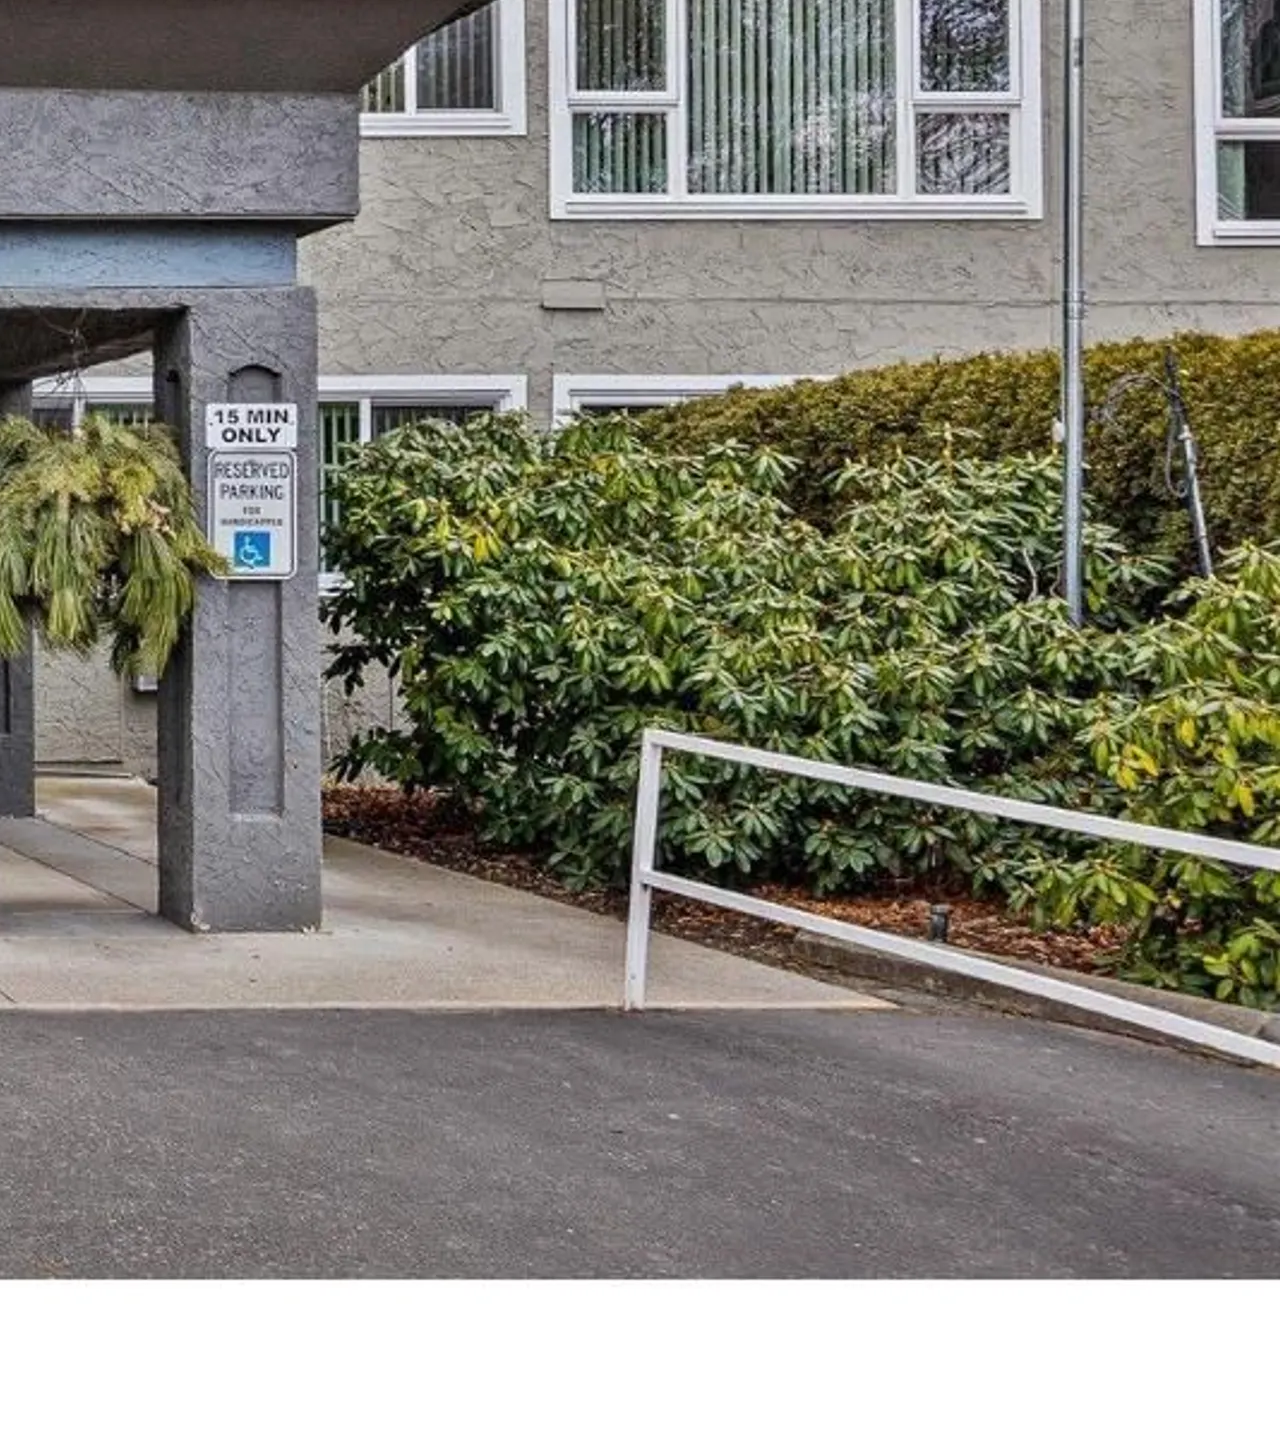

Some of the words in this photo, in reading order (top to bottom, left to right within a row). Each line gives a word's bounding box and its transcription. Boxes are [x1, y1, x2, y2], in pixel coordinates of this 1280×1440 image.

[214, 409, 240, 425] 15
[246, 409, 289, 425] MIN
[221, 427, 282, 444] ONLY
[214, 462, 290, 480] RESERVED
[219, 484, 284, 501] PARKING
